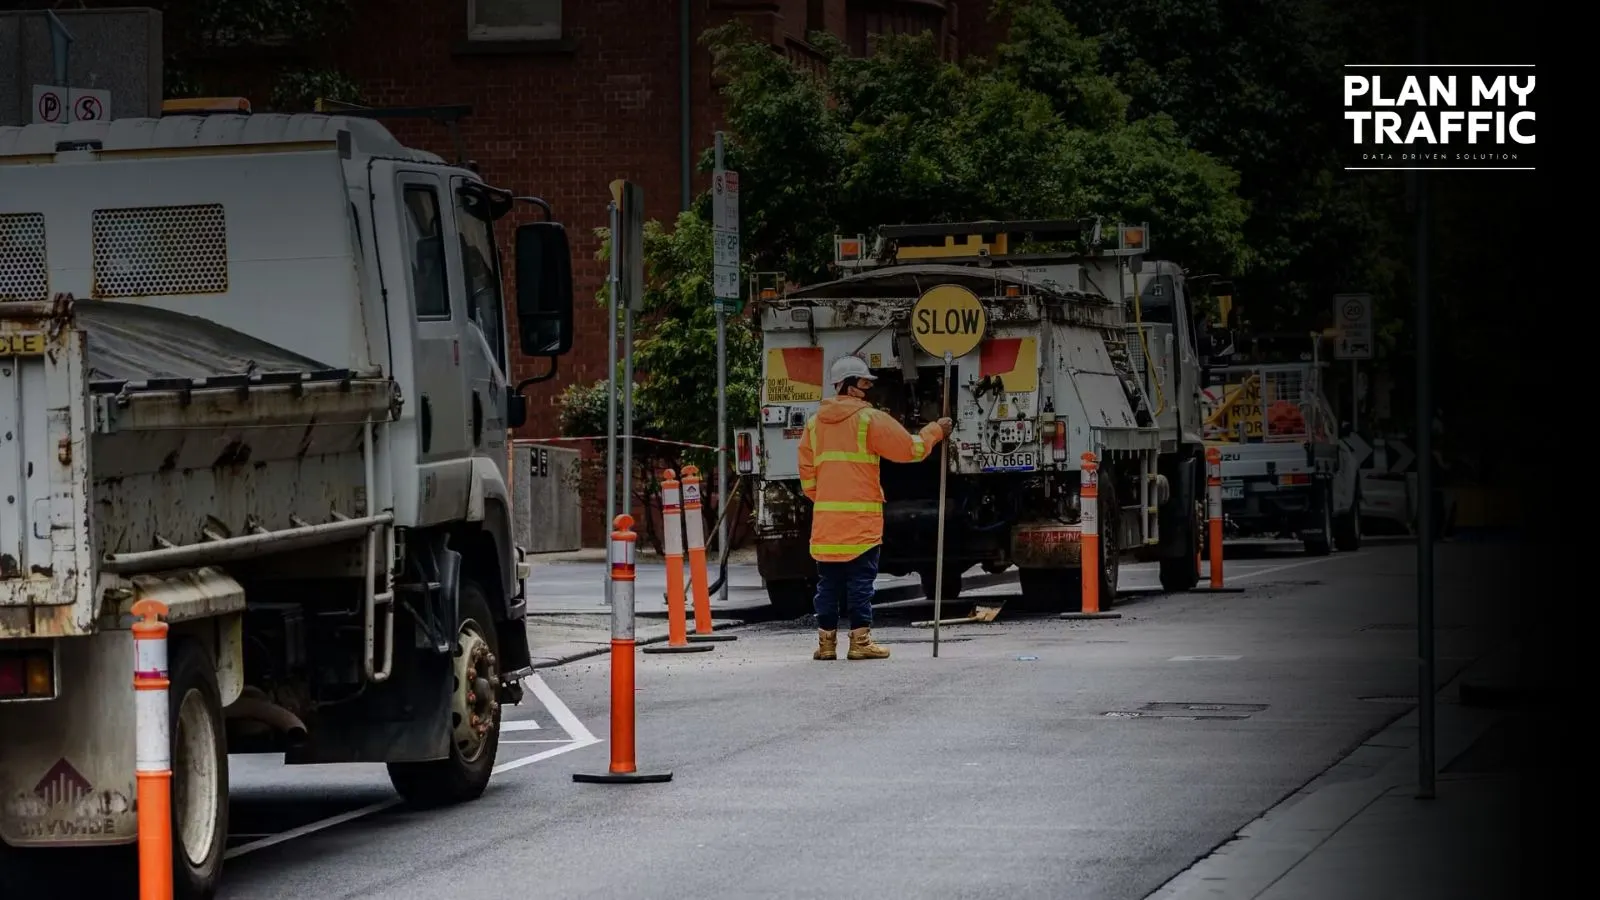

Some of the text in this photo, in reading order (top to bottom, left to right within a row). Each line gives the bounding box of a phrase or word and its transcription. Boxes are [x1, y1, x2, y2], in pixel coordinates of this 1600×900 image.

[727, 236, 738, 250] 2P
[728, 272, 737, 285] 1P
[916, 308, 980, 335] SLOW
[767, 385, 795, 394] OVERTAKE
[768, 392, 814, 401] TURNING VEHICLE
[982, 453, 1032, 467] XV 66GB
